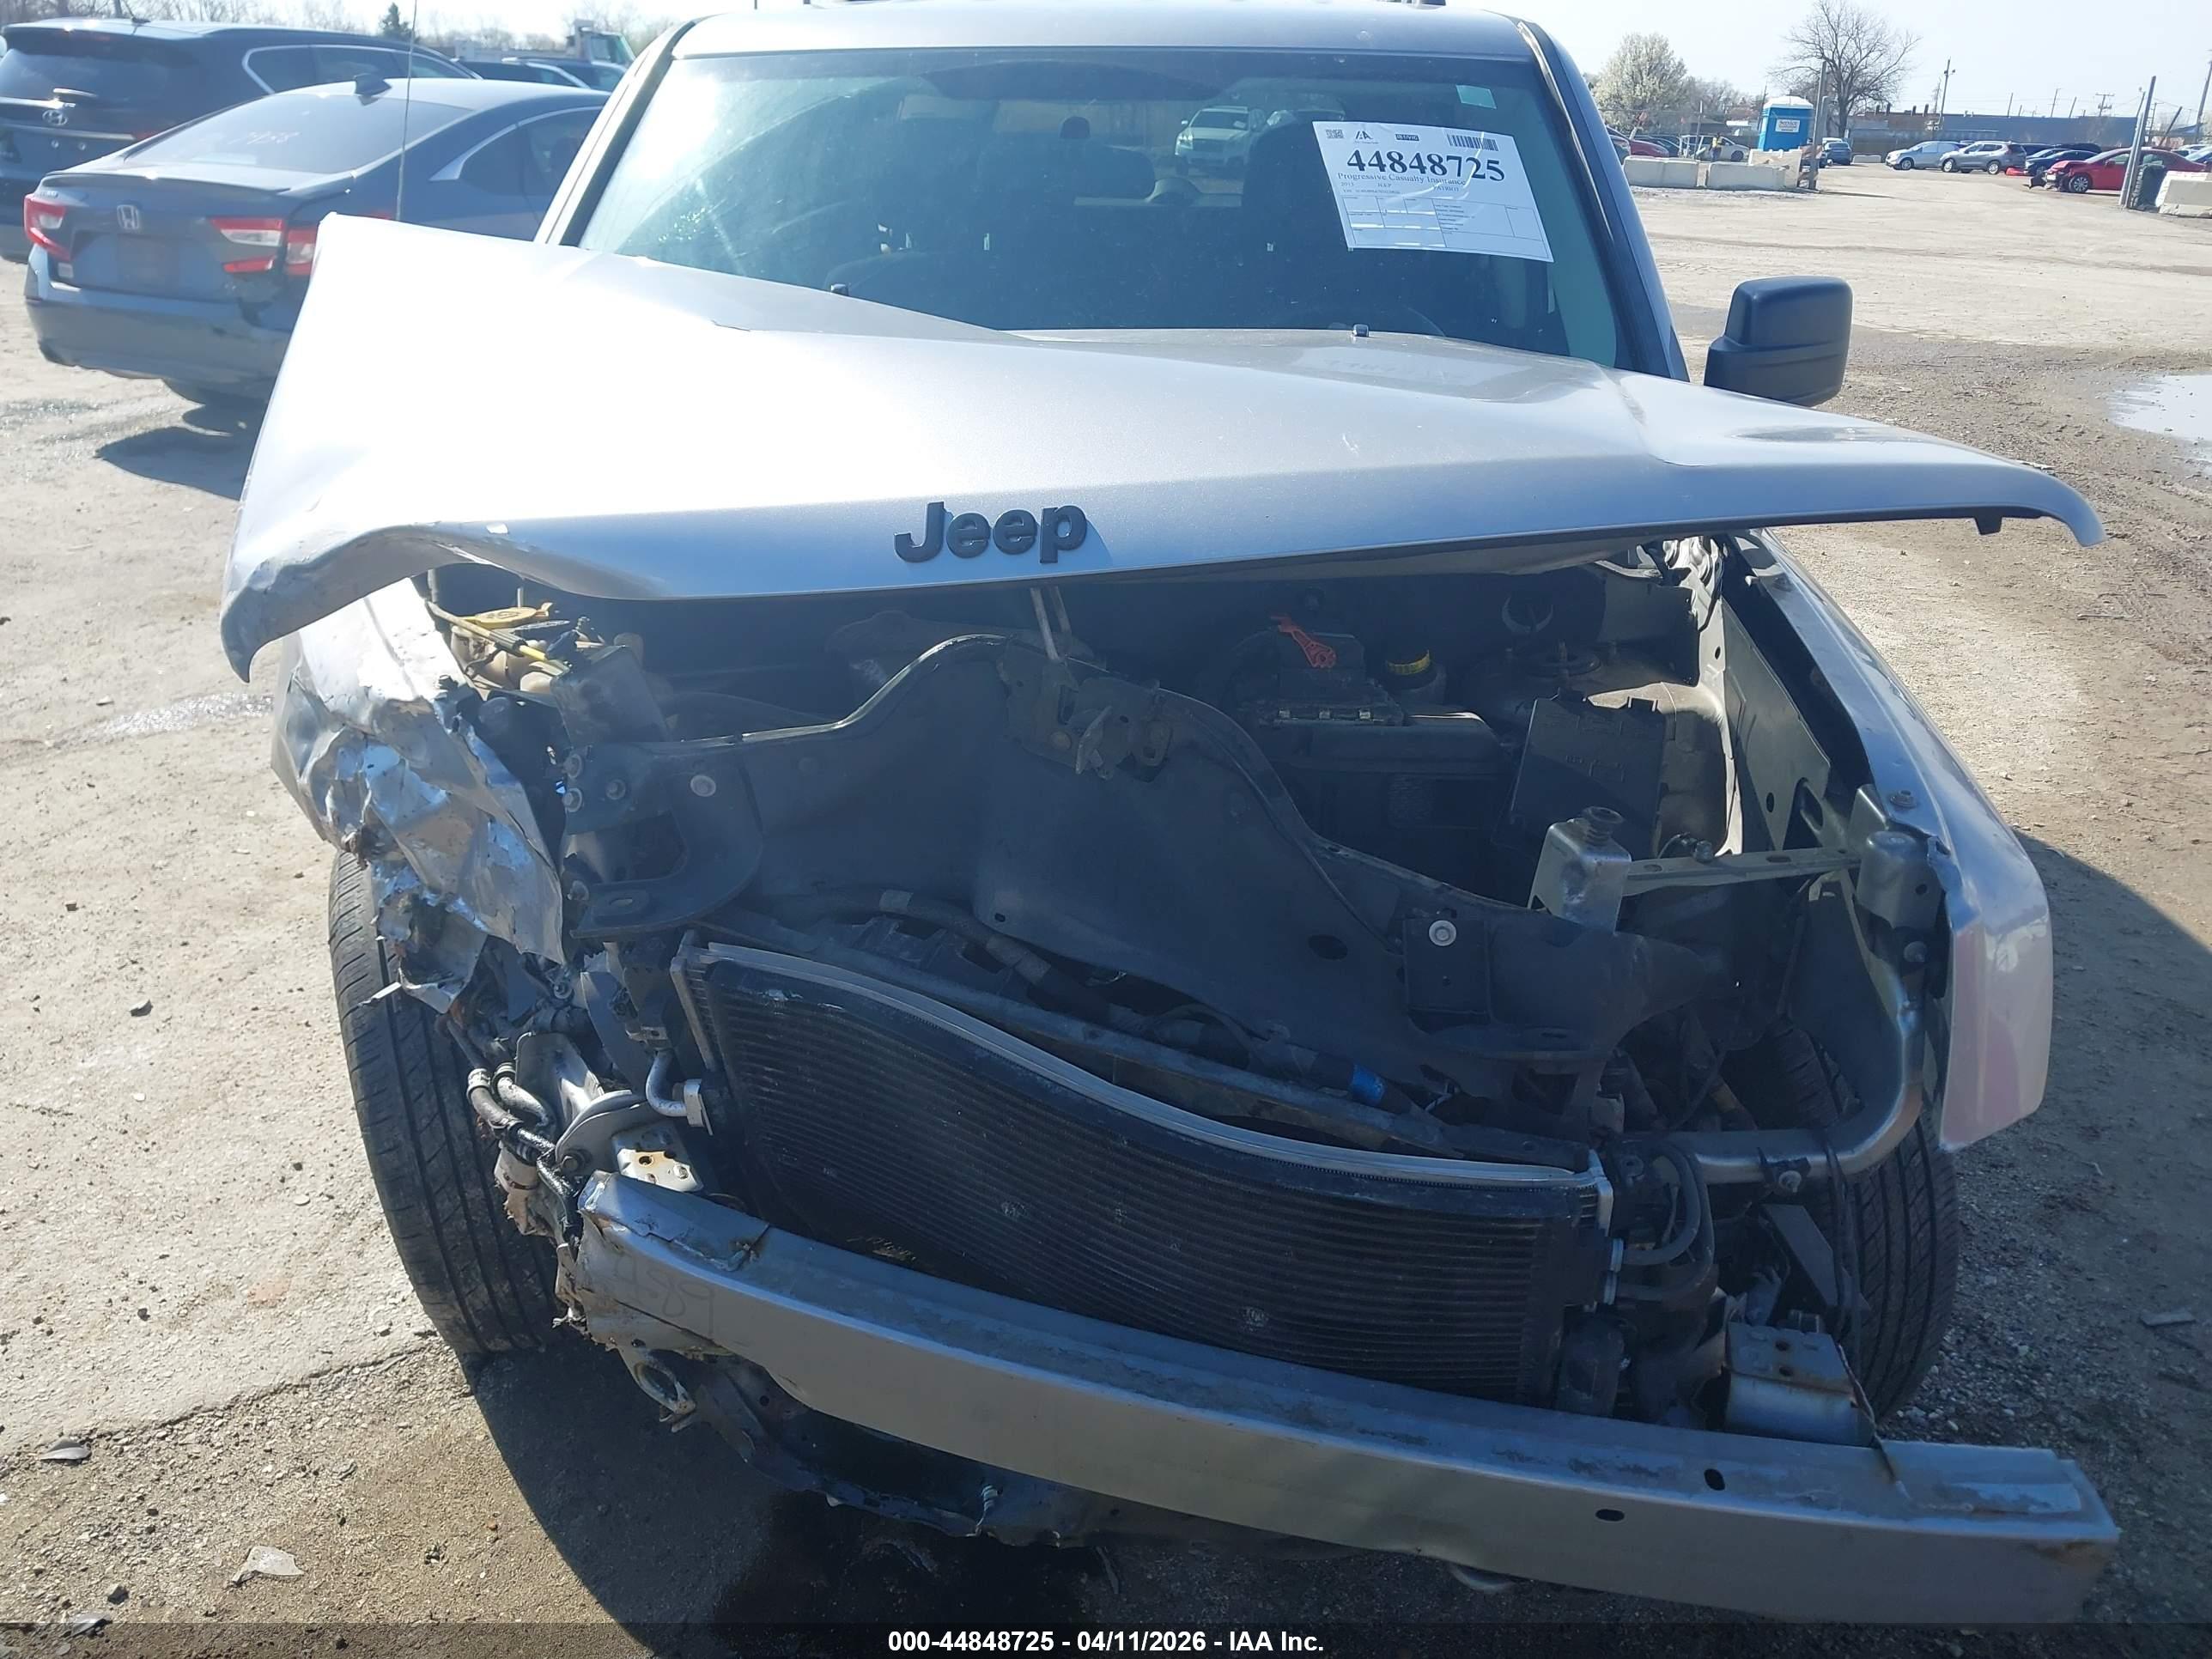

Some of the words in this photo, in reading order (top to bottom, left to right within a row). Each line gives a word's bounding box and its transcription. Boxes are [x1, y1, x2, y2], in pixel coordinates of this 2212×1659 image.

[1337, 173, 1387, 181] Progressive
[1389, 175, 1425, 184] Casualty
[1346, 149, 1505, 182] 44848725
[893, 501, 1088, 564] Jeep
